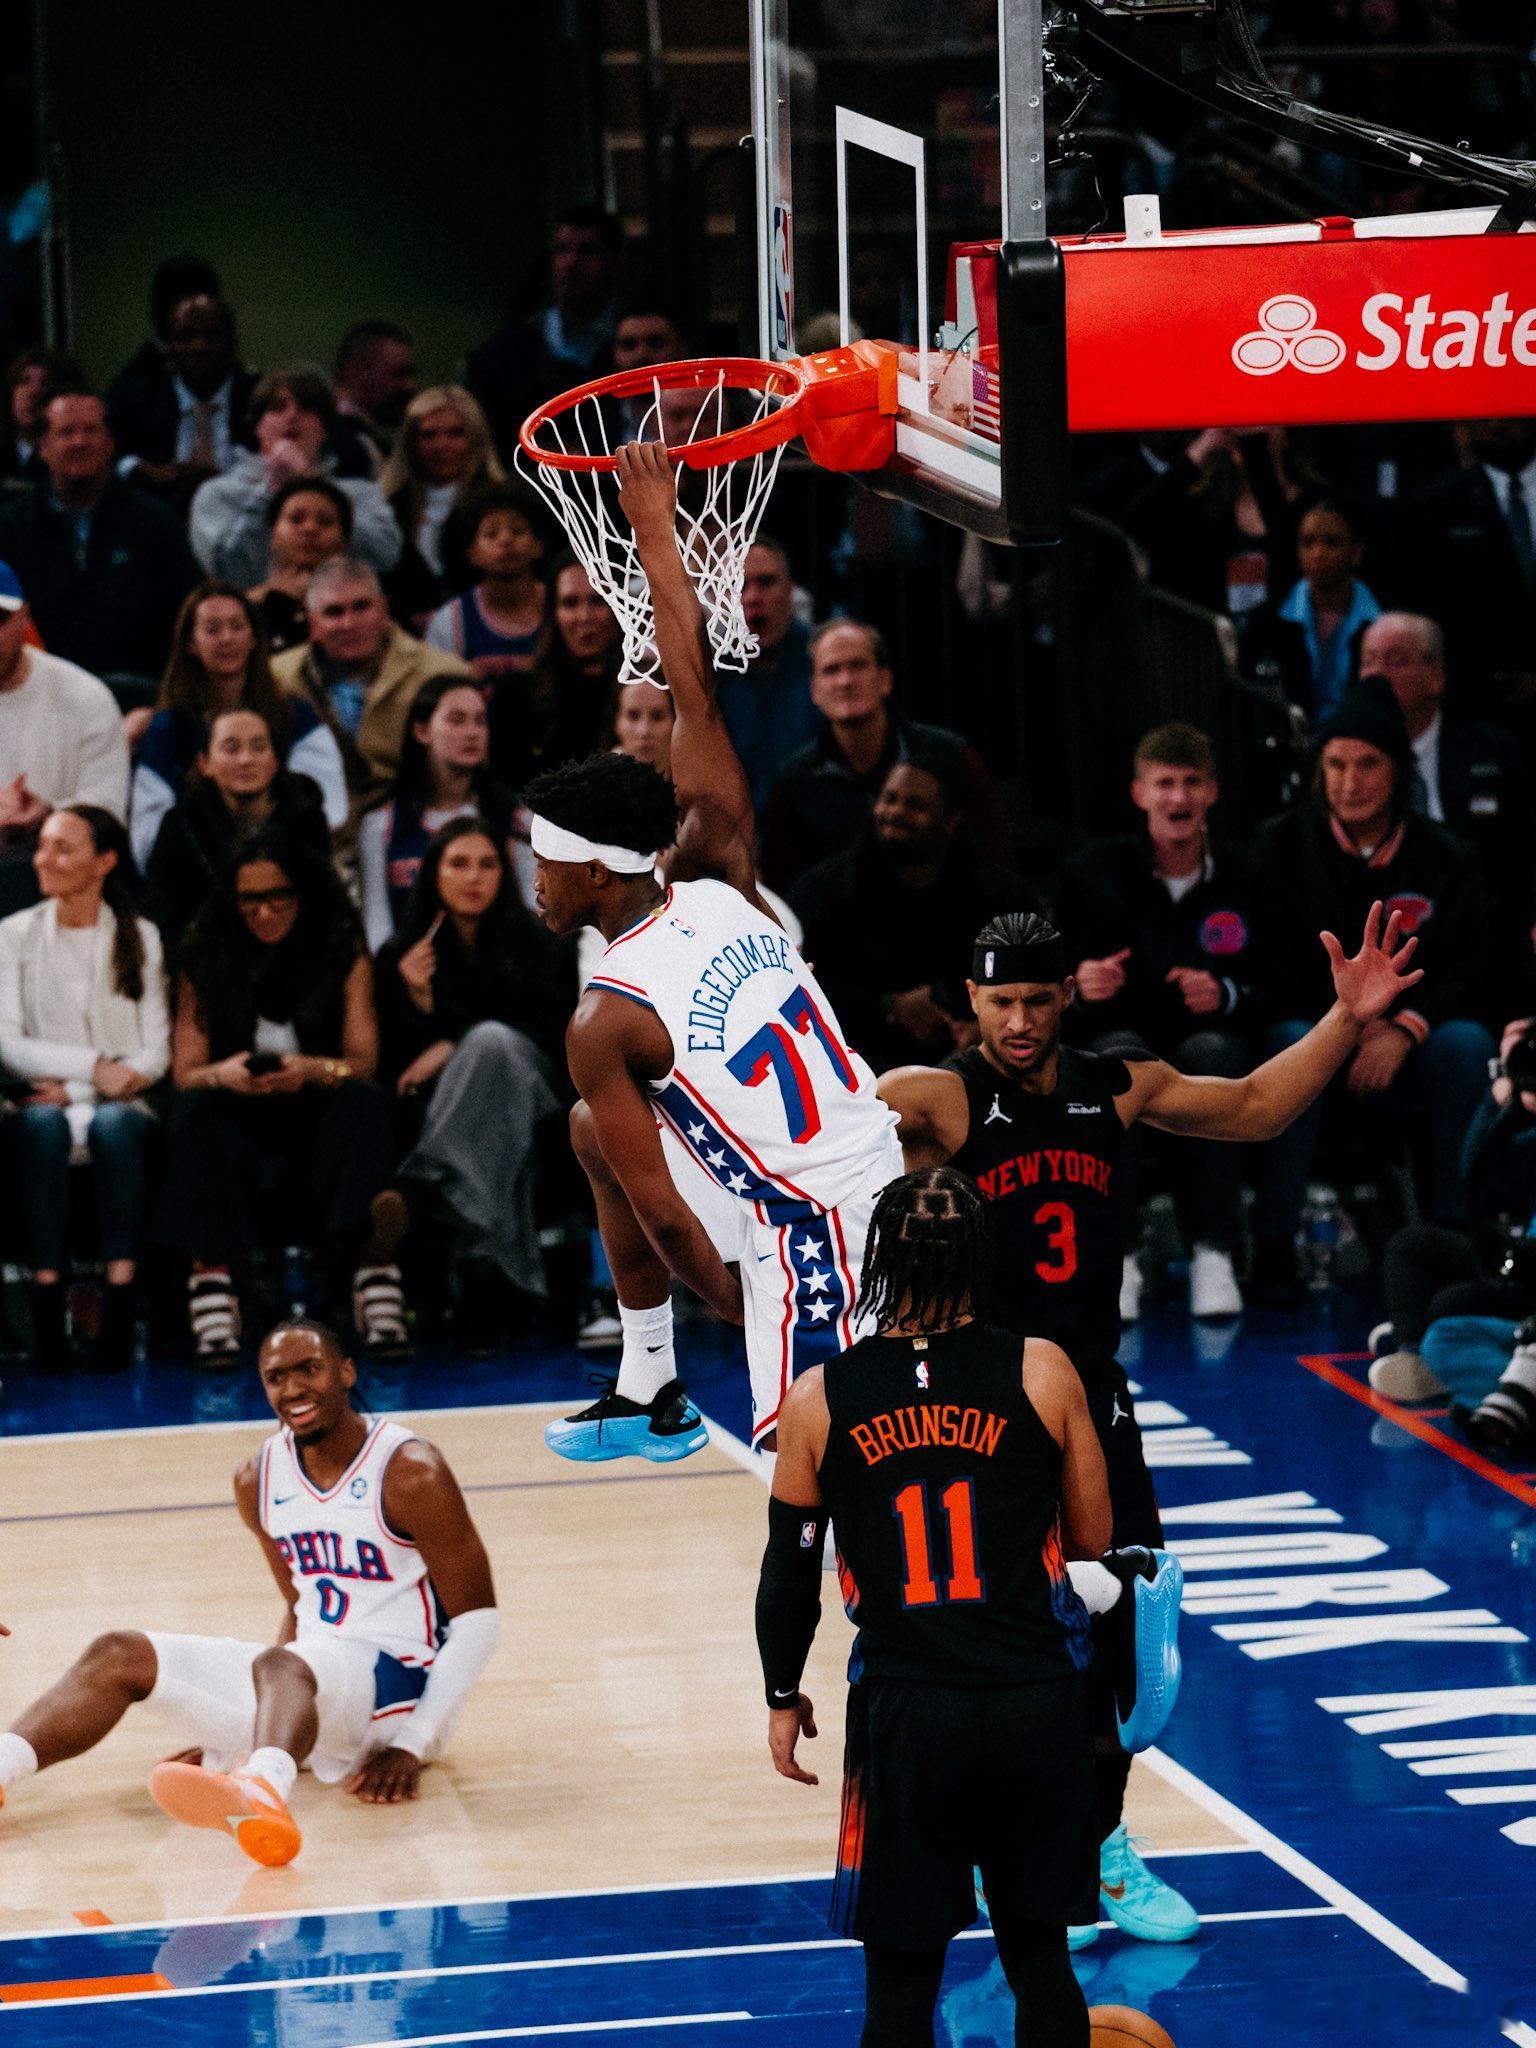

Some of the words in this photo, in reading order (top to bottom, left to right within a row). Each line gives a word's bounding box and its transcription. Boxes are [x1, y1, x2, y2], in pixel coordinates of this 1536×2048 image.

[1356, 292, 1536, 371] State
[687, 933, 794, 1053] EDGECOMBE
[724, 983, 860, 1145] 77
[976, 1151, 1042, 1201] NEW
[1044, 1149, 1112, 1197] YORK
[1033, 1202, 1079, 1284] 3
[849, 1404, 1008, 1467] BRUNSON
[892, 1476, 986, 1611] 11
[315, 1577, 350, 1626] 0
